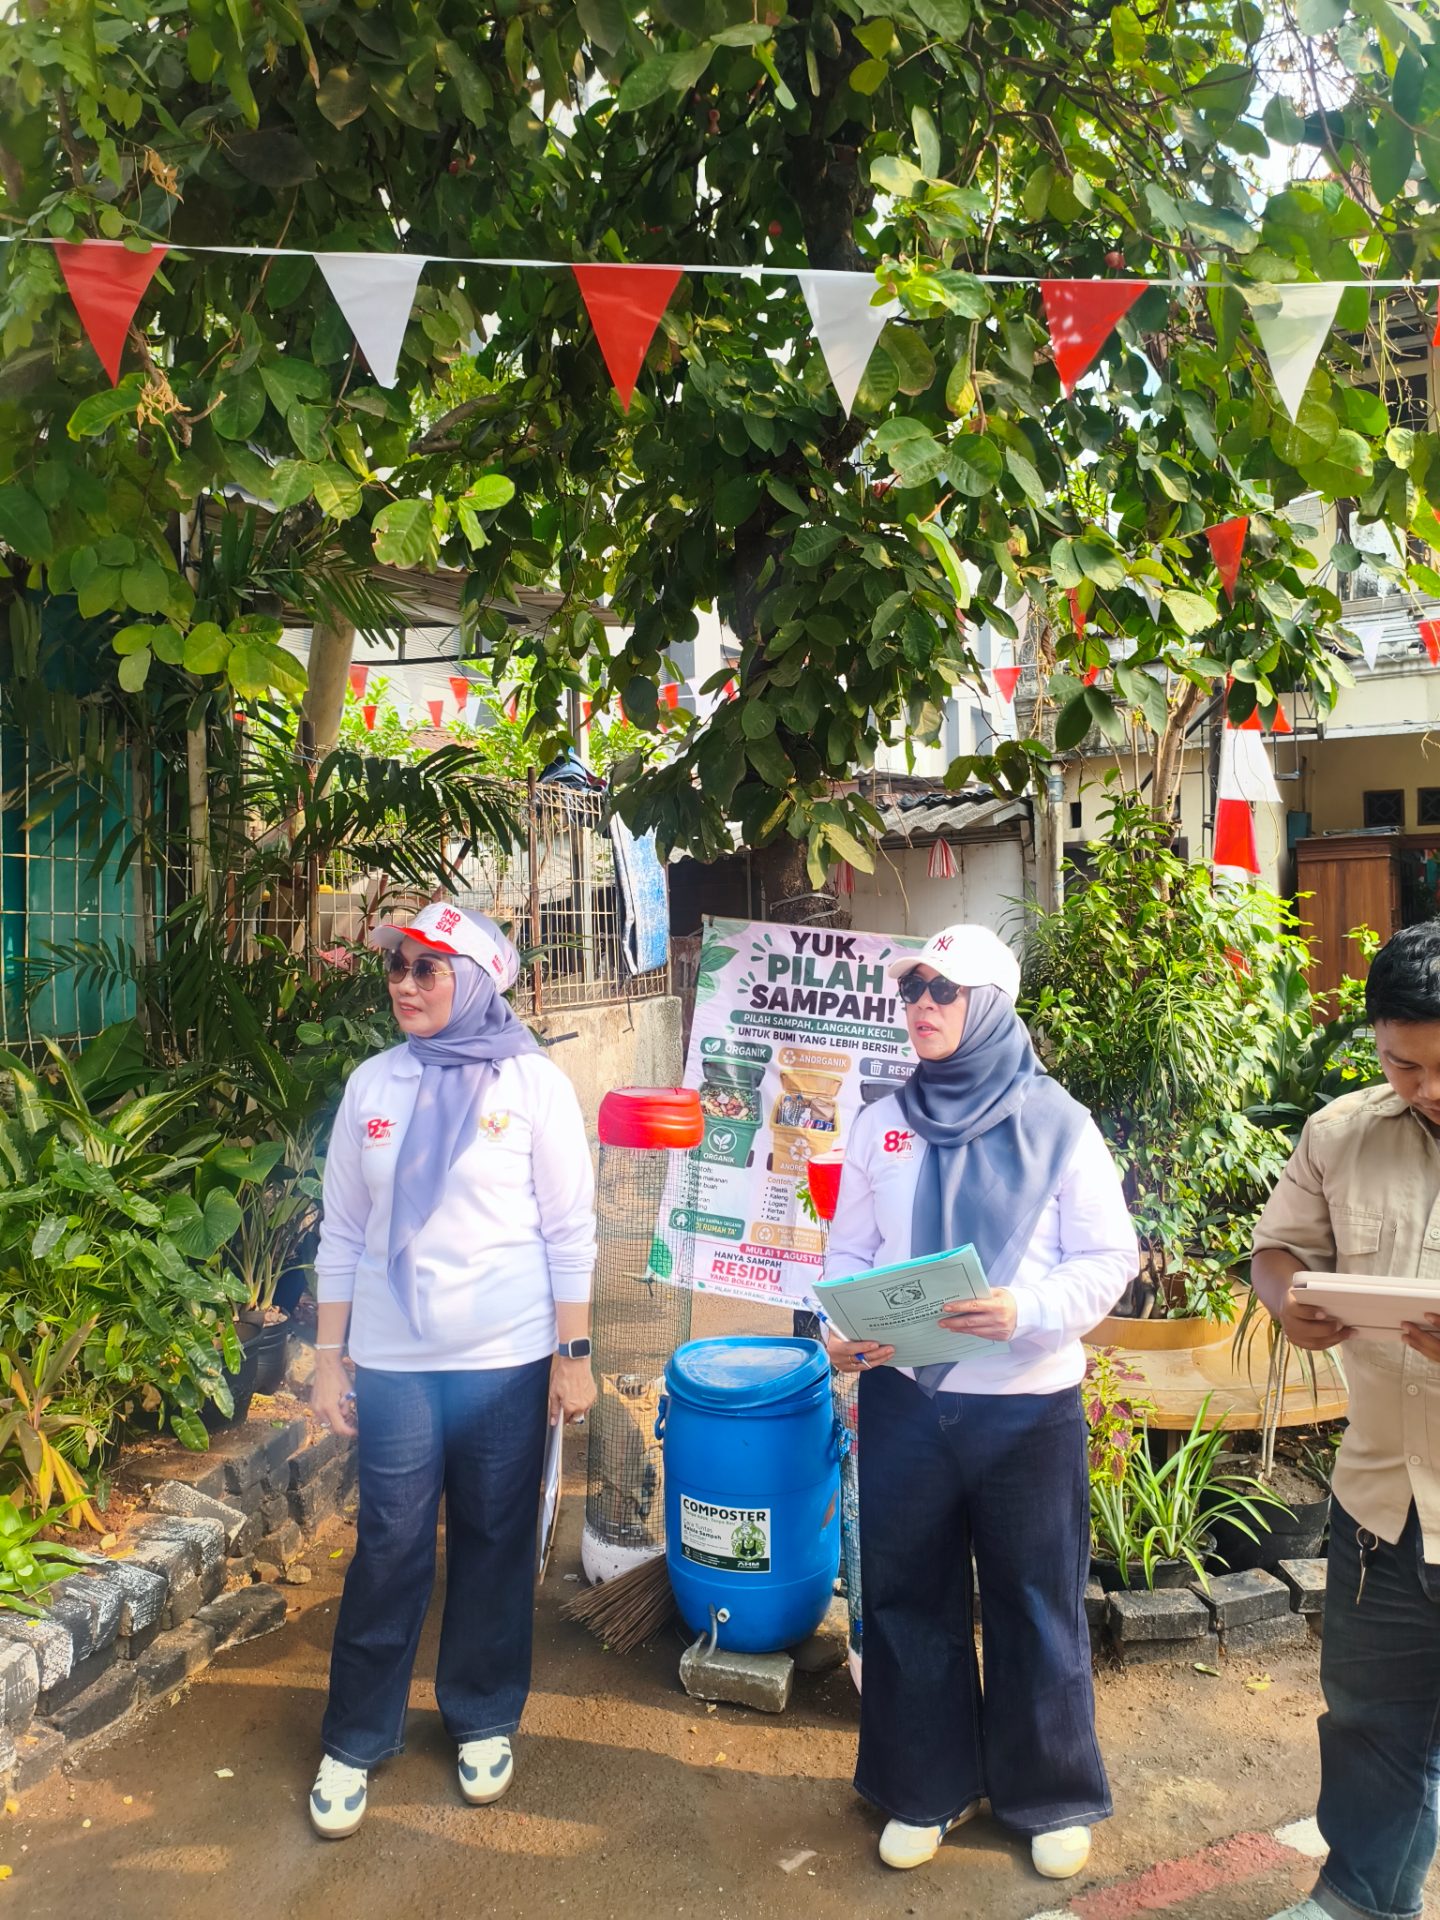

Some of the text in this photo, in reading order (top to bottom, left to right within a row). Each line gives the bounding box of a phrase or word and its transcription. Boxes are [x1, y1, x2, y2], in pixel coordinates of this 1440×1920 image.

[441, 916, 456, 928] ONE
[443, 909, 461, 922] IND
[436, 921, 452, 936] SIA
[790, 930, 865, 963] YUK,
[767, 954, 884, 994] PILAH
[750, 984, 896, 1024] SAMPAH!
[743, 1013, 896, 1039] PILAH SAMPAH, LANGKAH KECIL
[738, 1027, 898, 1055] UNTUK BUMI YANG LEBIH BERSIH
[725, 1043, 767, 1058] ORGANIK
[799, 1054, 847, 1068] ANORGANIK
[703, 1152, 735, 1164] ORGANIK
[769, 1193, 789, 1202] Kaleng
[770, 1186, 788, 1194] Plastik
[767, 1207, 785, 1215] Kertas
[768, 1200, 788, 1209] Logam
[744, 1245, 774, 1257] MULAI
[776, 1249, 780, 1258] 1
[714, 1251, 782, 1268] HANYA SAMPAH
[711, 1259, 782, 1284] RESIDU
[710, 1273, 783, 1292] YANG BOLEH KE TPA
[683, 1498, 767, 1522] COMPOSTER
